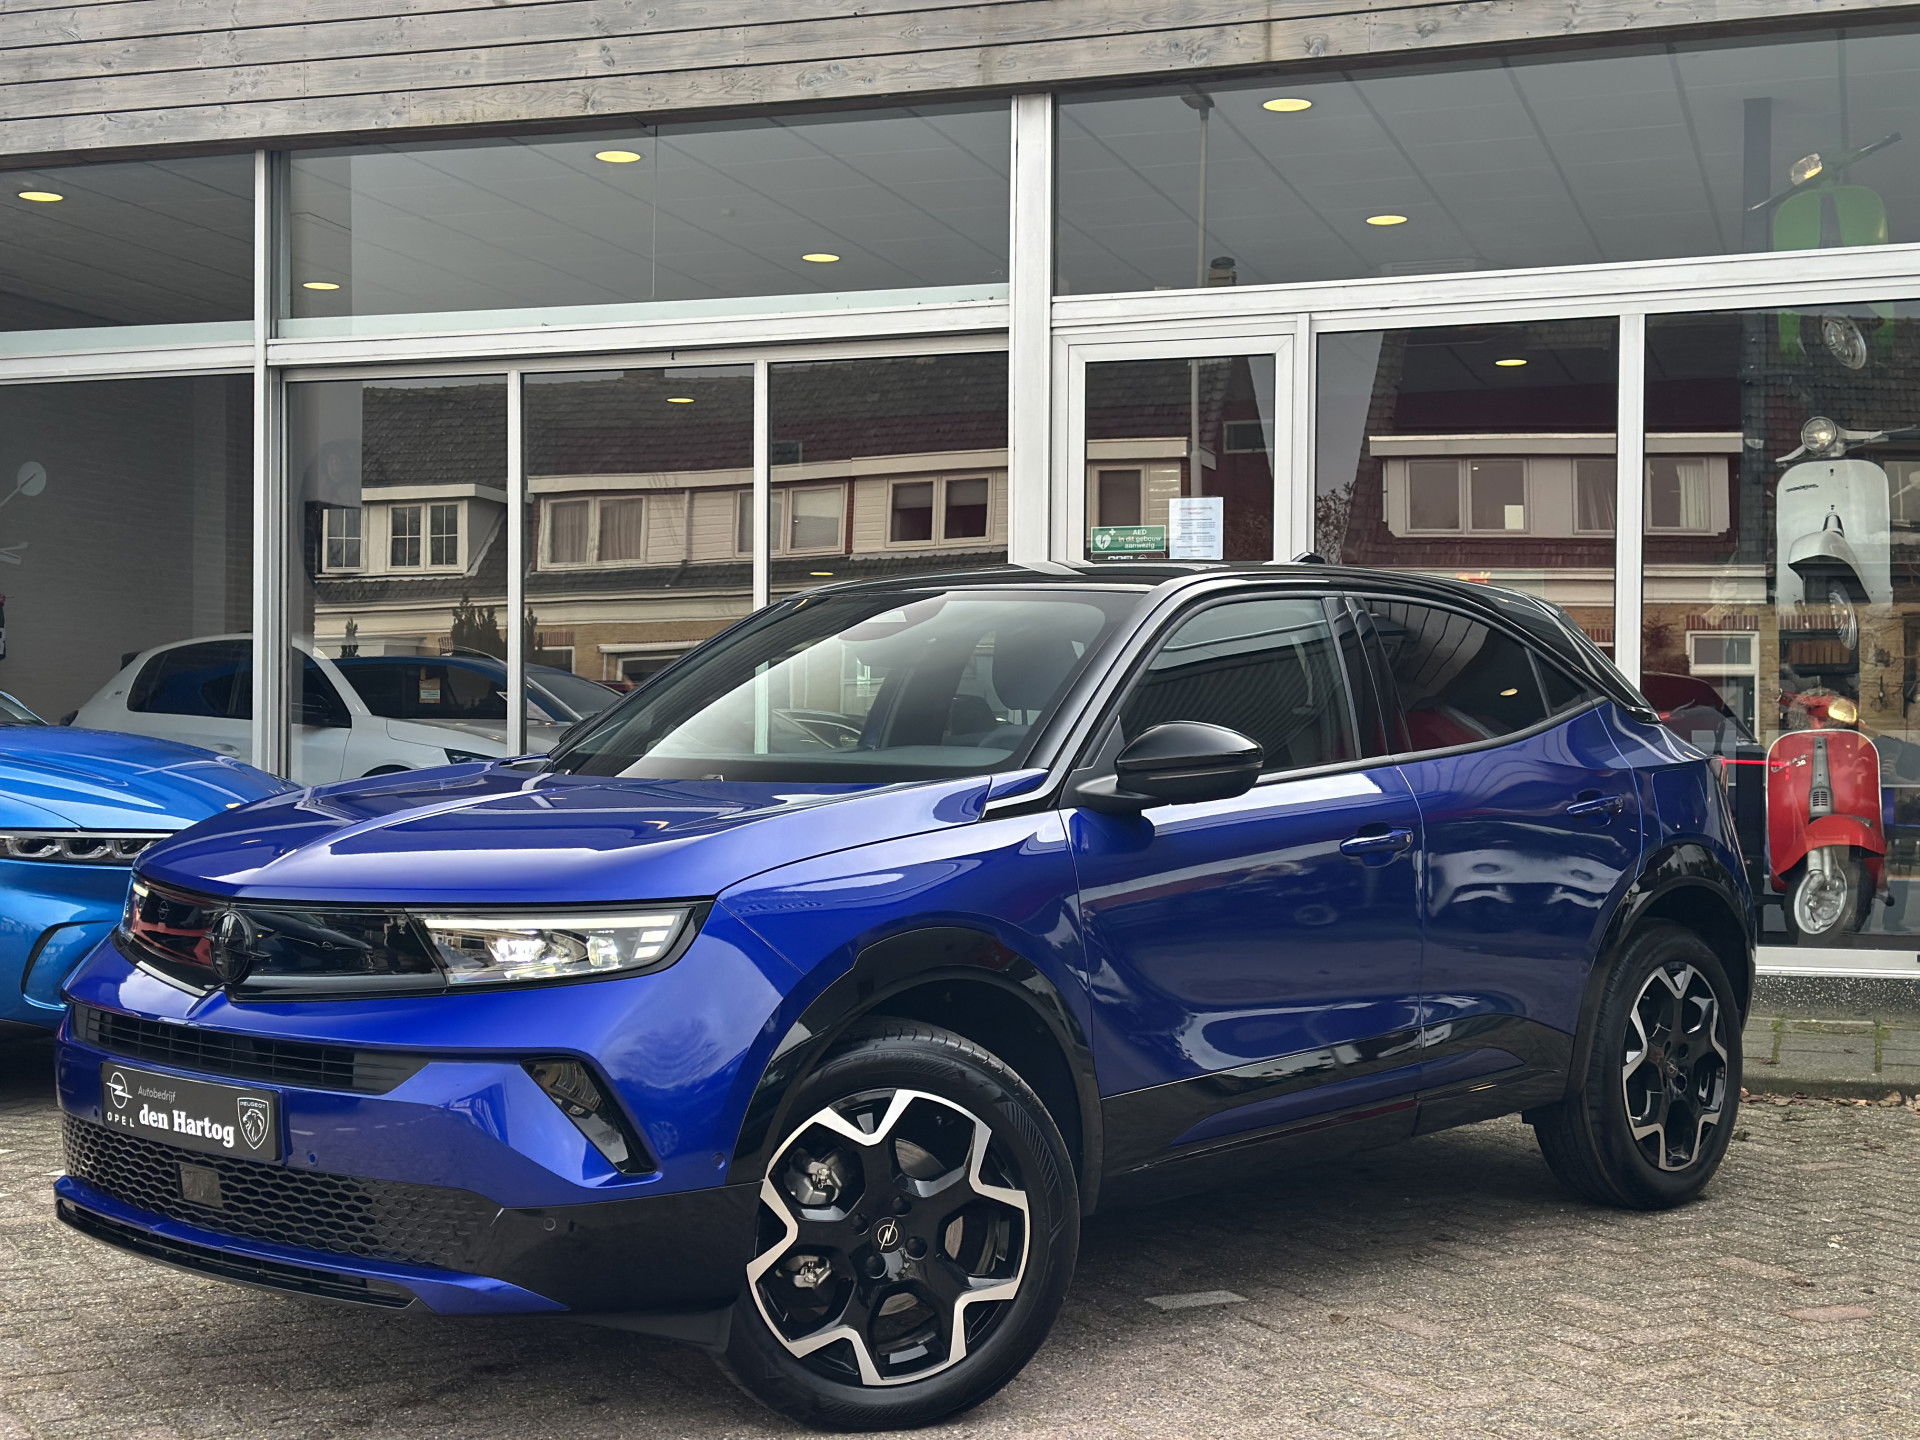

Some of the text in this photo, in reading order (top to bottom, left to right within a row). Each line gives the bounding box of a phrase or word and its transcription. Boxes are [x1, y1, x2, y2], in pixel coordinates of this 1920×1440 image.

[1132, 528, 1147, 536] AED
[137, 1085, 176, 1103] Autobedrijf
[239, 1101, 267, 1109] PEUGEOT
[107, 1111, 135, 1128] OPEL
[138, 1103, 235, 1148] den Hartog
